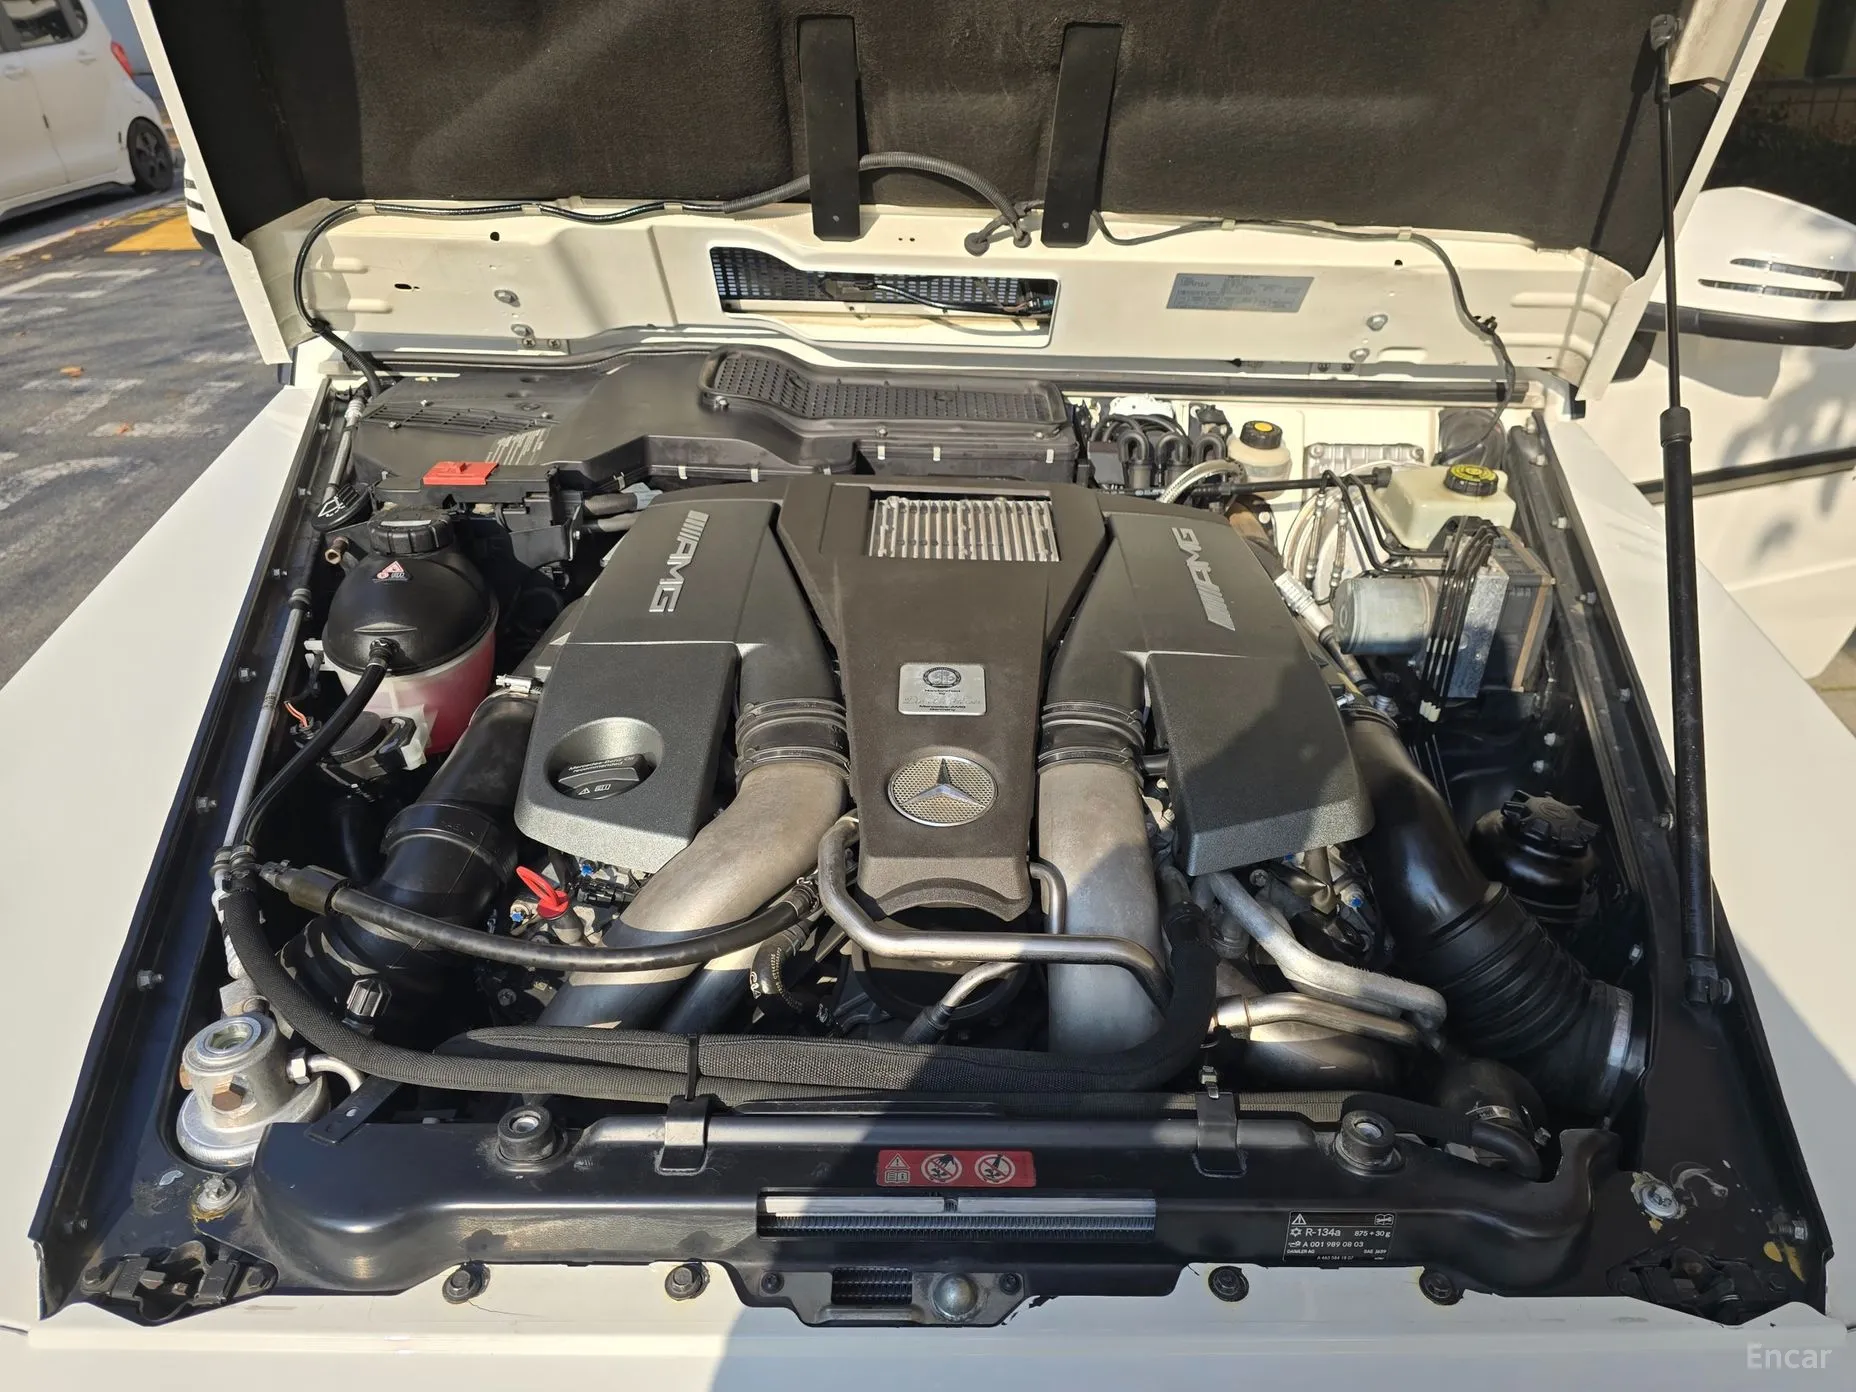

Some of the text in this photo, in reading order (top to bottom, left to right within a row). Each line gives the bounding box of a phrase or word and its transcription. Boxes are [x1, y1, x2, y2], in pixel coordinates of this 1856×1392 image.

[649, 532, 700, 613] AMG
[1171, 527, 1222, 598] AMG
[1305, 1227, 1341, 1237] R-134a
